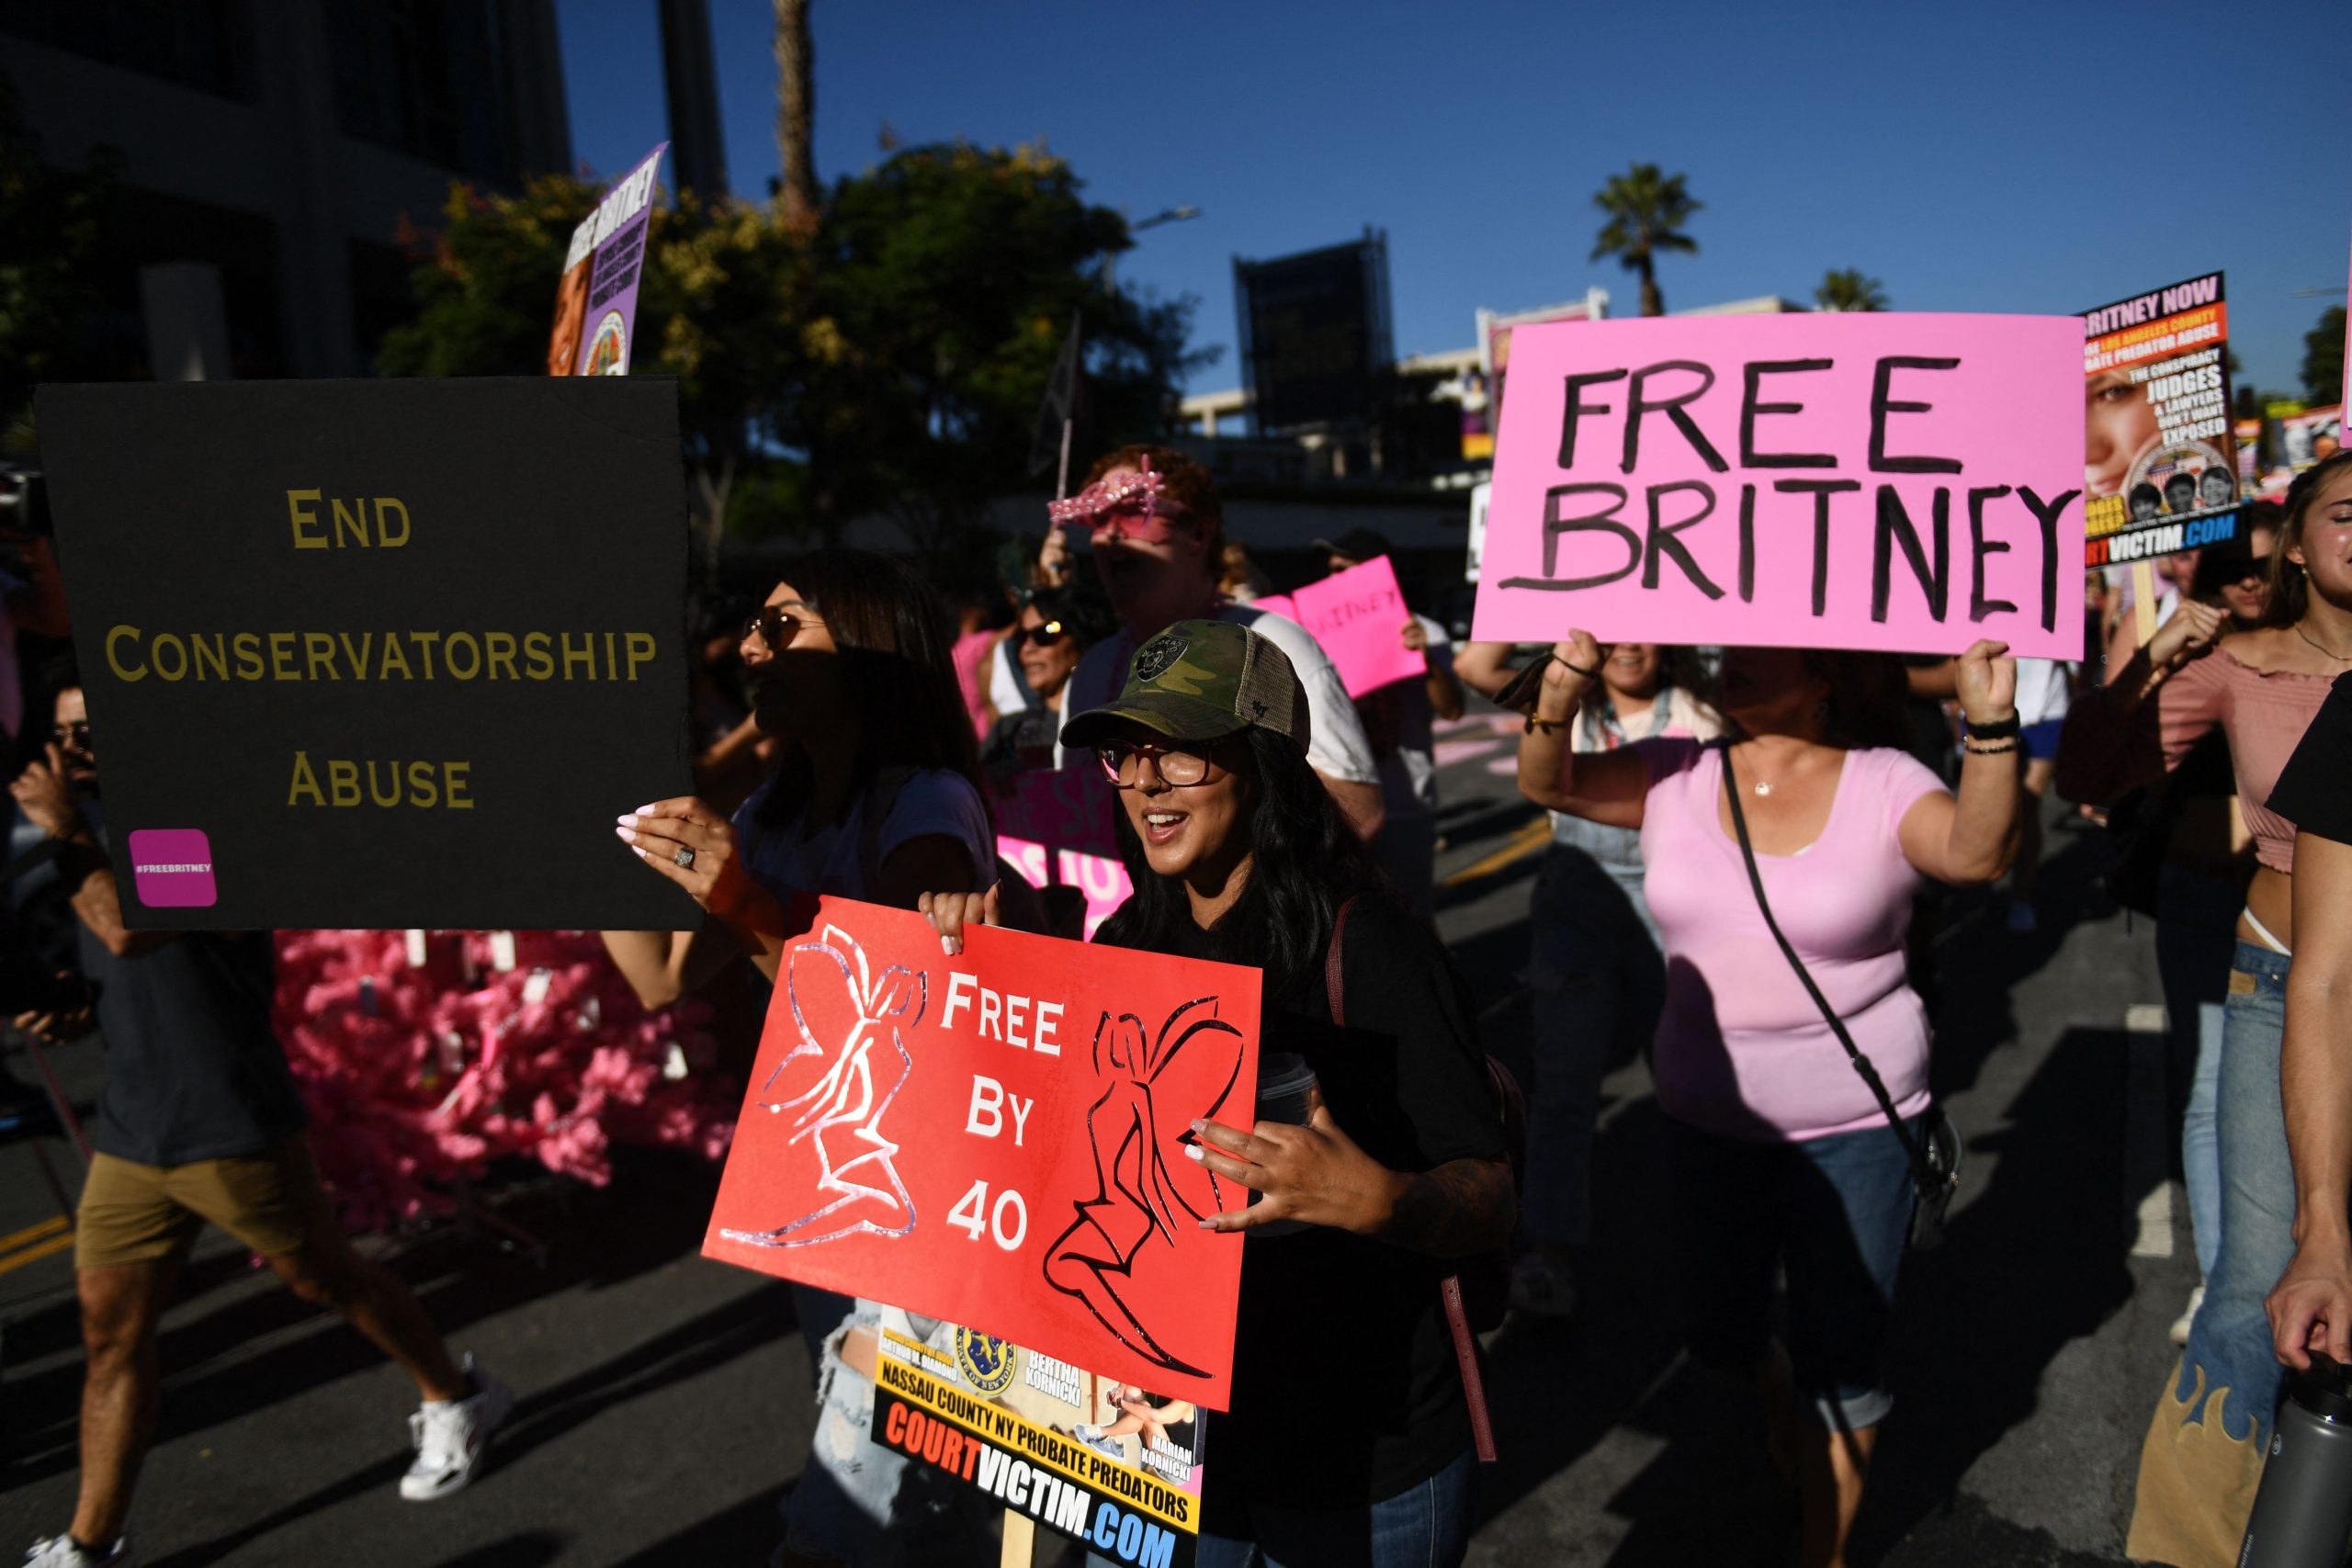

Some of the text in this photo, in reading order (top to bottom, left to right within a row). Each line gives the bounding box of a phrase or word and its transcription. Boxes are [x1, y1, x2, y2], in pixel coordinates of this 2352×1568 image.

[2085, 276, 2218, 338] RITNEY NOW
[2170, 309, 2217, 334] COUNTY
[2114, 334, 2177, 364] PREDATOR
[2177, 321, 2219, 347] ABUSE
[2129, 348, 2221, 384] THE CONSPIRACY
[2146, 364, 2222, 405] JUDGES
[1556, 355, 1963, 475] FREE
[2165, 387, 2223, 413] LAWYERS
[2190, 402, 2225, 423] WANT
[2162, 416, 2226, 448] EXPOSED
[286, 488, 412, 550] END
[1498, 478, 2082, 634] BRITNEY
[105, 625, 657, 682] CONSERVATORSHIP
[287, 750, 475, 809] ABUSE
[136, 863, 211, 873] #FREEBRITNEY
[939, 971, 1065, 1057] FREE
[965, 1074, 1035, 1147] BY
[945, 1179, 1029, 1251] 40
[880, 1337, 912, 1362] ARTHUR
[922, 1353, 958, 1382] DIAMOND
[969, 1371, 980, 1385] OF
[981, 1378, 1000, 1391] NEW
[999, 1357, 1014, 1385] YORK
[1029, 1349, 1080, 1388] BERTHA
[1025, 1367, 1082, 1408] KORNICKI
[882, 1360, 1188, 1524] NASSAU COUNTY NY PROBATE PREDATORS
[1151, 1435, 1193, 1465] MARIAN
[885, 1401, 1177, 1568] COURTVICTIM.COM
[1141, 1447, 1192, 1483] KORNICKI
